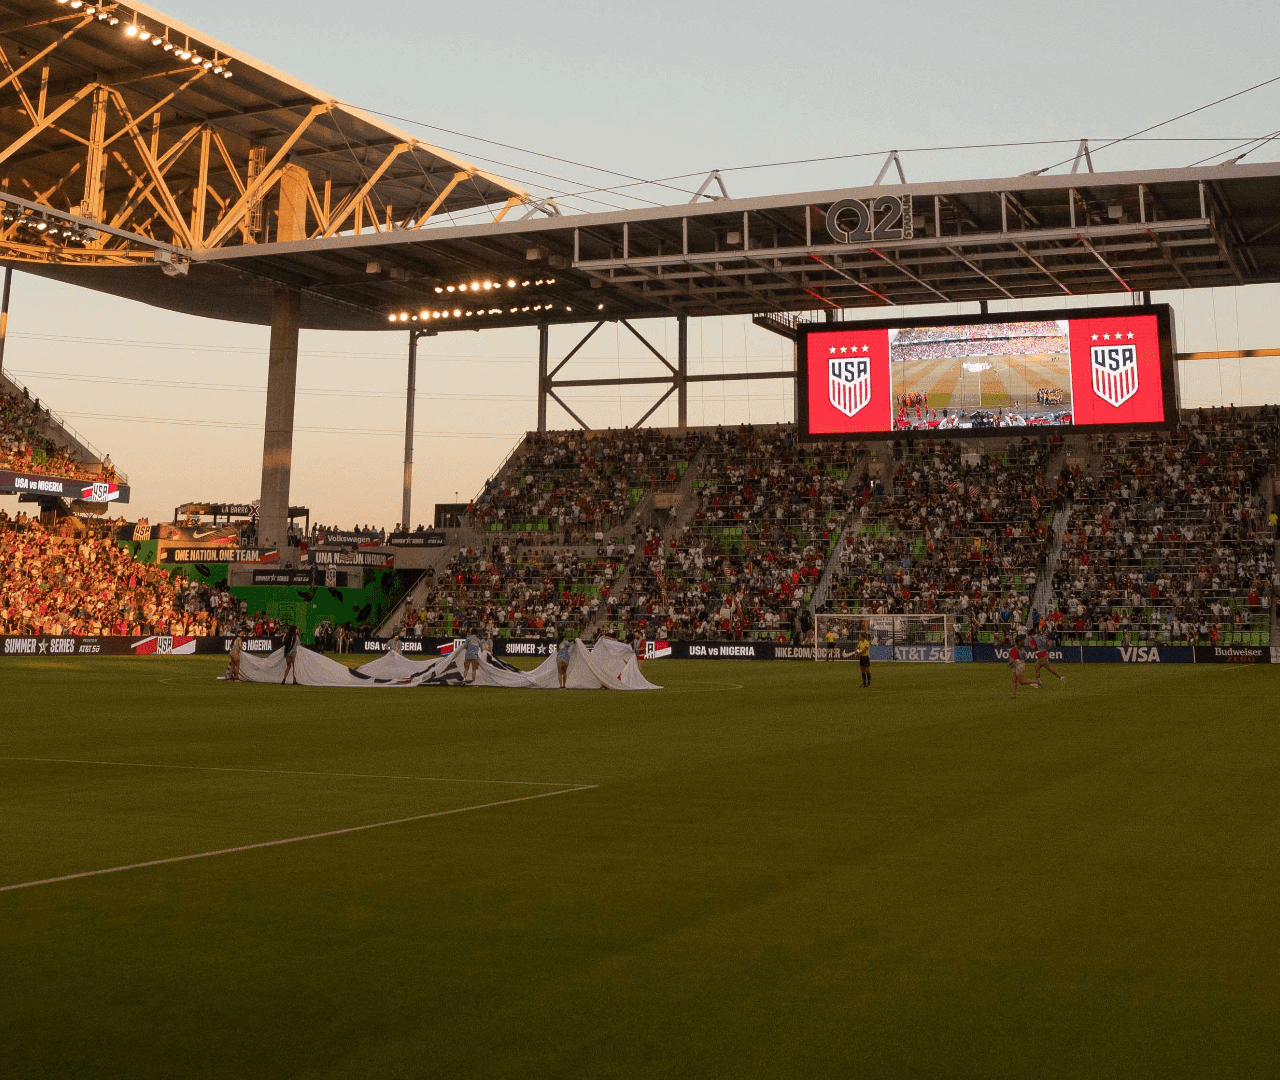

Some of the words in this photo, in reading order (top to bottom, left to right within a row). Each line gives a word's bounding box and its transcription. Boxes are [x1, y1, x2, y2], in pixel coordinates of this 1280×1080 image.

[826, 195, 903, 243] Q2
[902, 193, 913, 239] STADIUM
[1094, 348, 1133, 371] USA
[832, 361, 867, 382] USA
[15, 477, 28, 488] USA
[29, 480, 37, 490] vs
[37, 480, 63, 492] NIGERIA
[93, 485, 108, 500] USA
[135, 526, 150, 536] USA
[328, 535, 370, 543] Volkswagen
[175, 550, 189, 561] ONE
[190, 550, 218, 561] NATION.
[219, 550, 234, 561] ONE
[236, 550, 260, 561] TEAM.
[316, 552, 332, 563] UNA
[4, 638, 37, 653] SUMMER
[50, 639, 75, 653] SERIES
[79, 645, 91, 653] AT&T
[158, 637, 172, 652] USA
[248, 639, 272, 651] NIGERIA
[364, 641, 380, 651] USA
[506, 643, 535, 654] SUMMER
[689, 646, 707, 656] USA
[708, 648, 719, 656] vs
[720, 646, 755, 656] NIGERIA
[894, 647, 927, 660] AT&T
[1116, 647, 1160, 662] VISA
[1215, 647, 1262, 656] Budweiser
